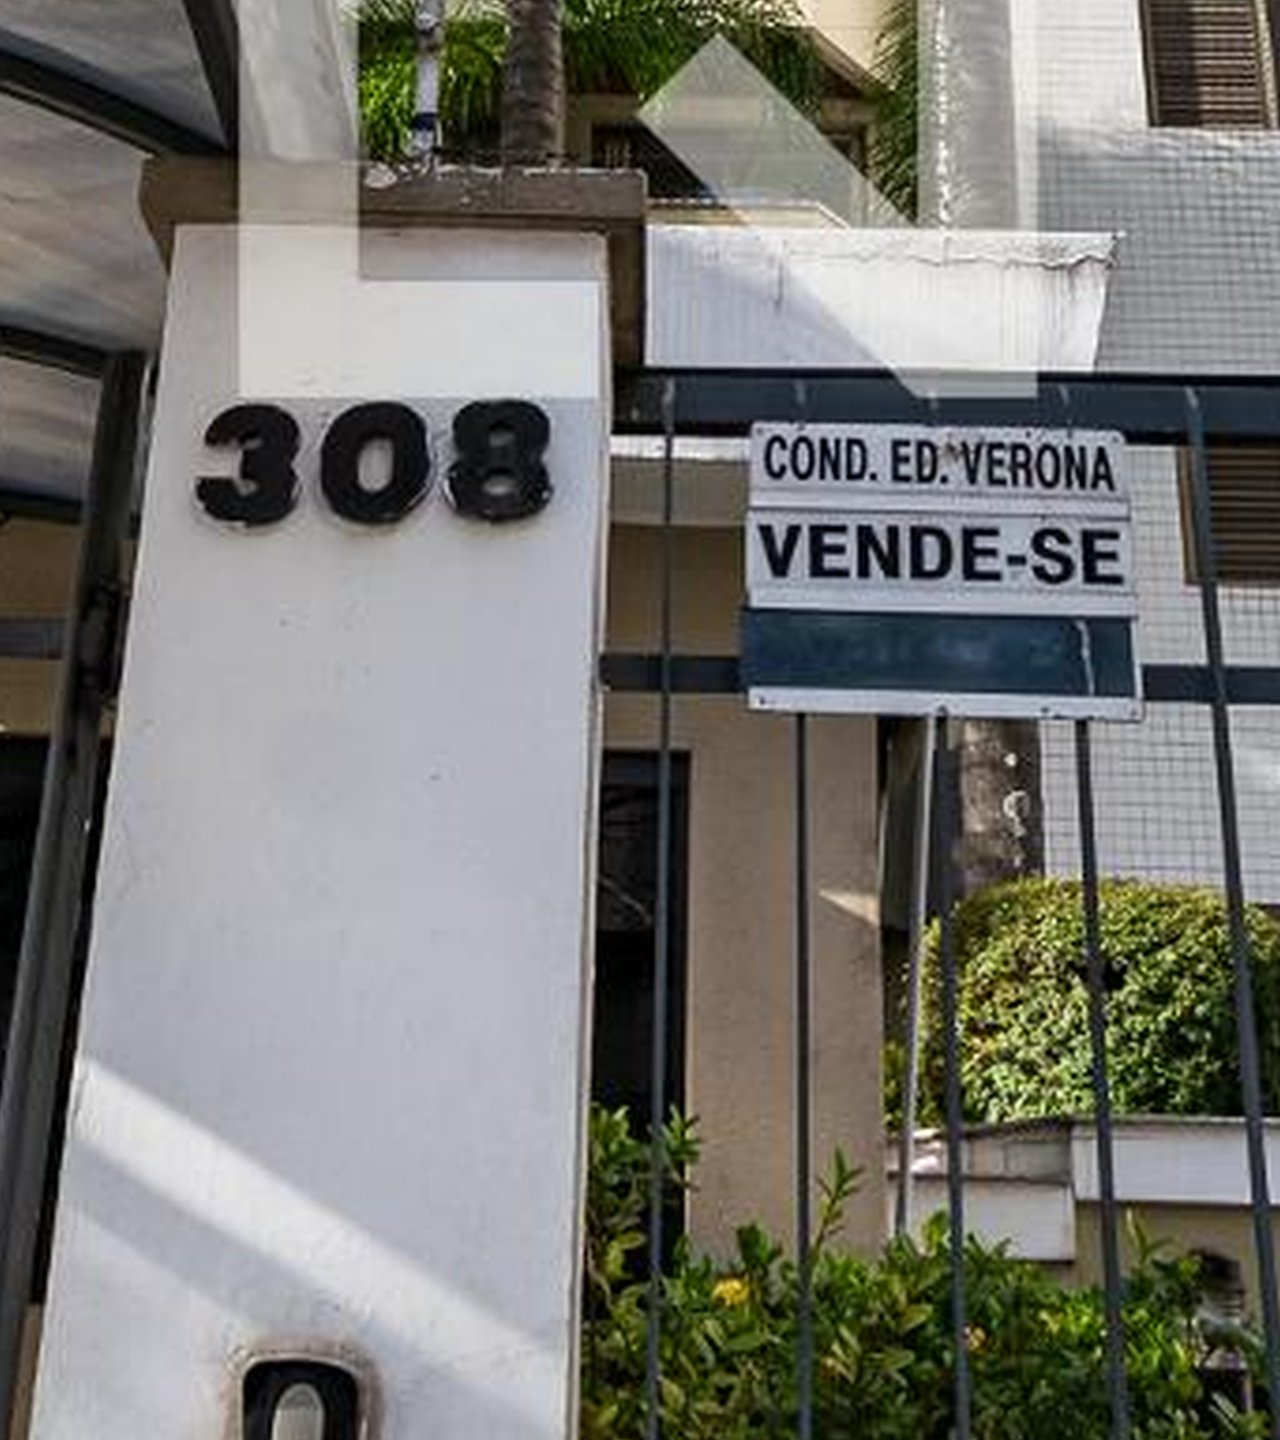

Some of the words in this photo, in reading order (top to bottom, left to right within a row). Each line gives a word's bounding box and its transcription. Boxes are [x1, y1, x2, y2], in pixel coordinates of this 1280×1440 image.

[196, 399, 553, 527] 308
[763, 435, 877, 483] COND.
[891, 439, 949, 485] ED.
[960, 442, 1116, 492] VERONA
[757, 523, 1125, 586] VENDE-SE
